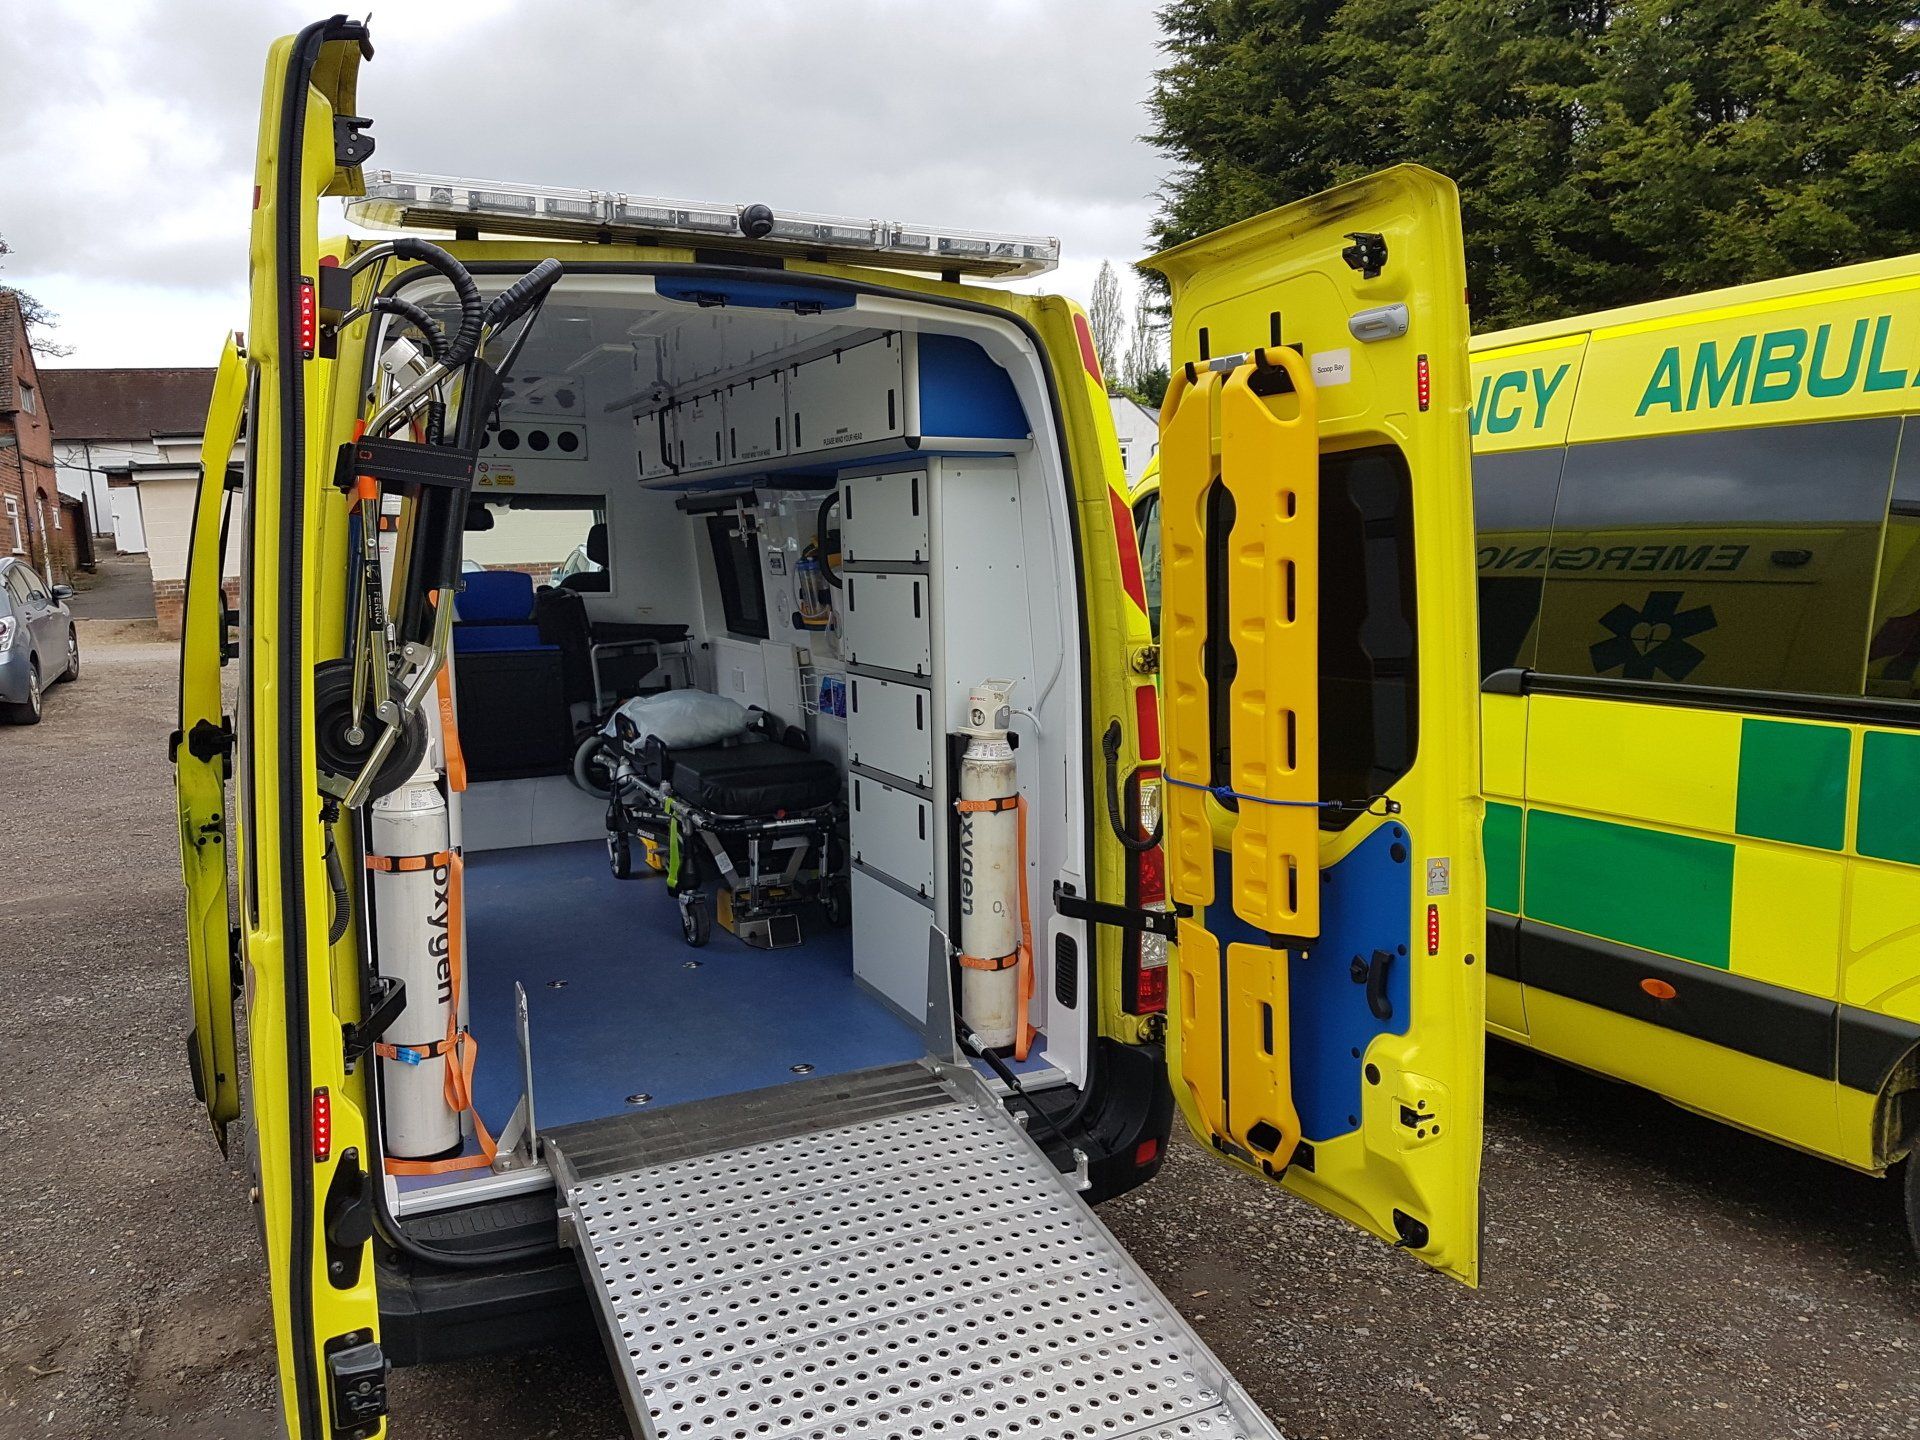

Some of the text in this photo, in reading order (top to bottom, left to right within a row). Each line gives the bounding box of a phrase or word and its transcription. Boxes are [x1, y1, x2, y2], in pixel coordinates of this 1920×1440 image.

[1317, 363, 1344, 374] Scoop Bay
[1635, 314, 1920, 417] AMBUL
[373, 591, 383, 625] FERNO
[427, 865, 453, 1005] oxygen
